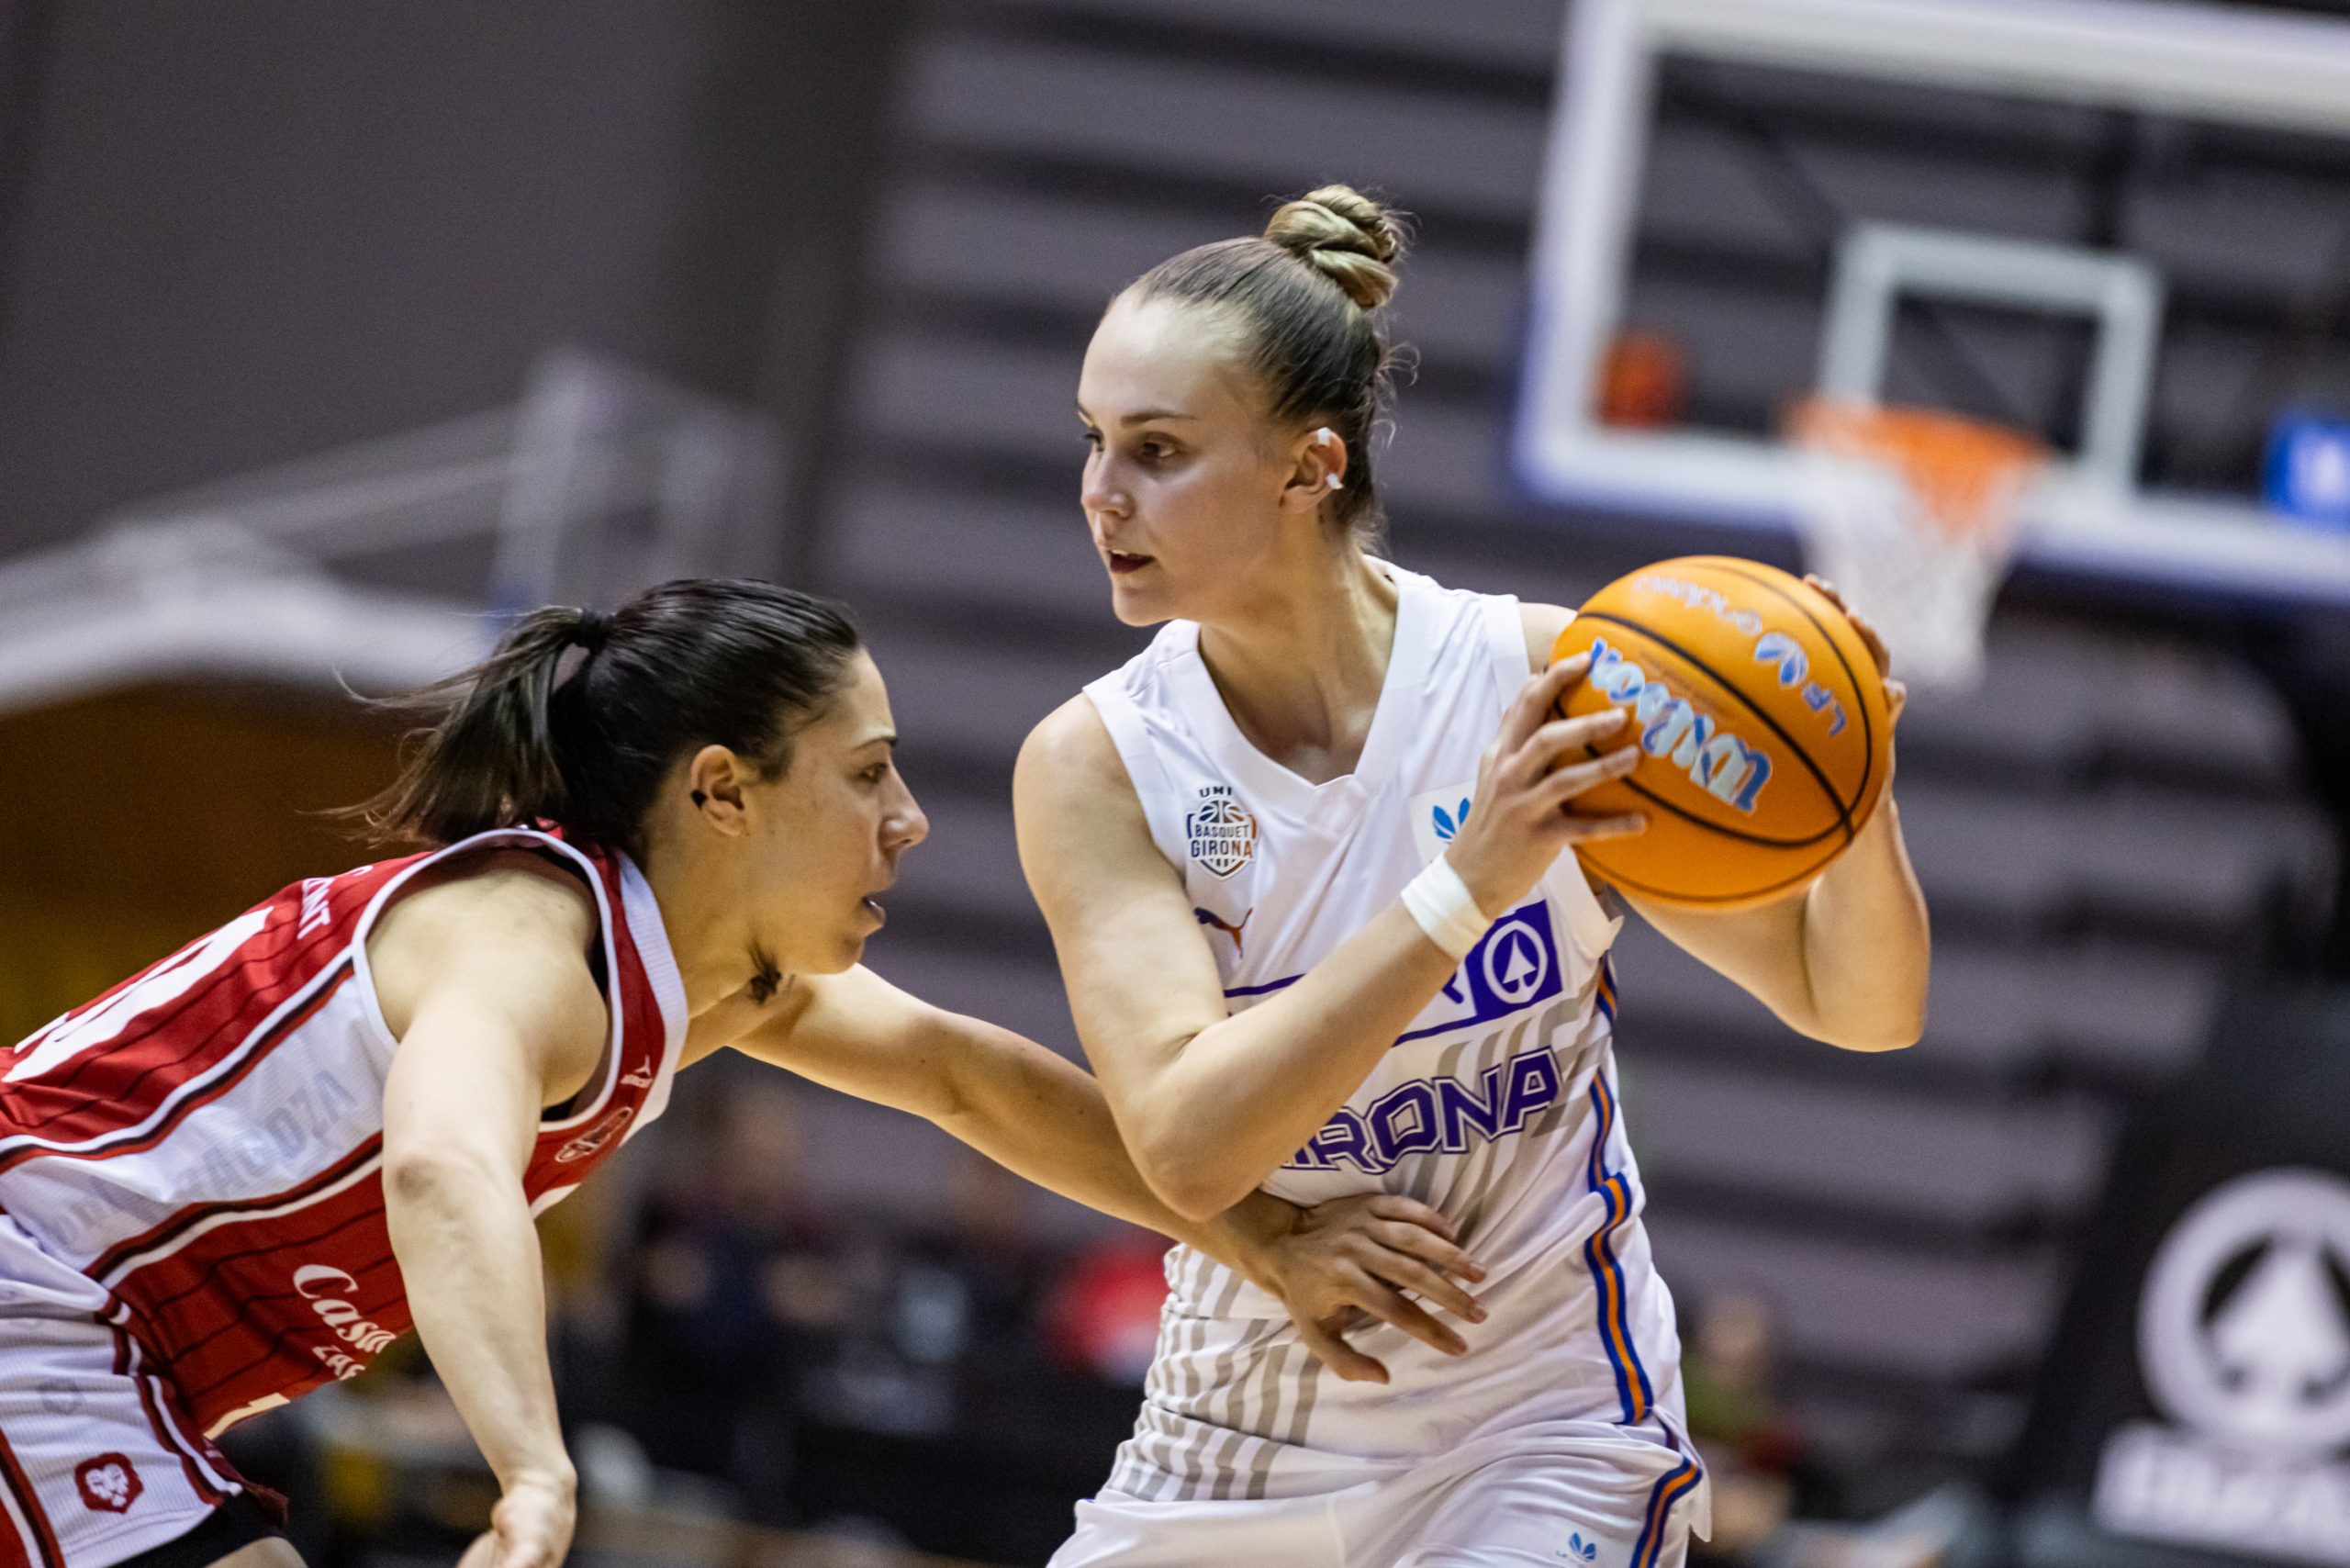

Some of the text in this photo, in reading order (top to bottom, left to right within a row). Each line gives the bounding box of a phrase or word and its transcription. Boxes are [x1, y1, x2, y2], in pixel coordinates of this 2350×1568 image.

[1590, 636, 1774, 813] Wilson
[1199, 786, 1232, 798] UNI
[1195, 823, 1249, 838] BASQUET
[1191, 839, 1253, 858] GIRONA
[1281, 1045, 1561, 1175] RONA
